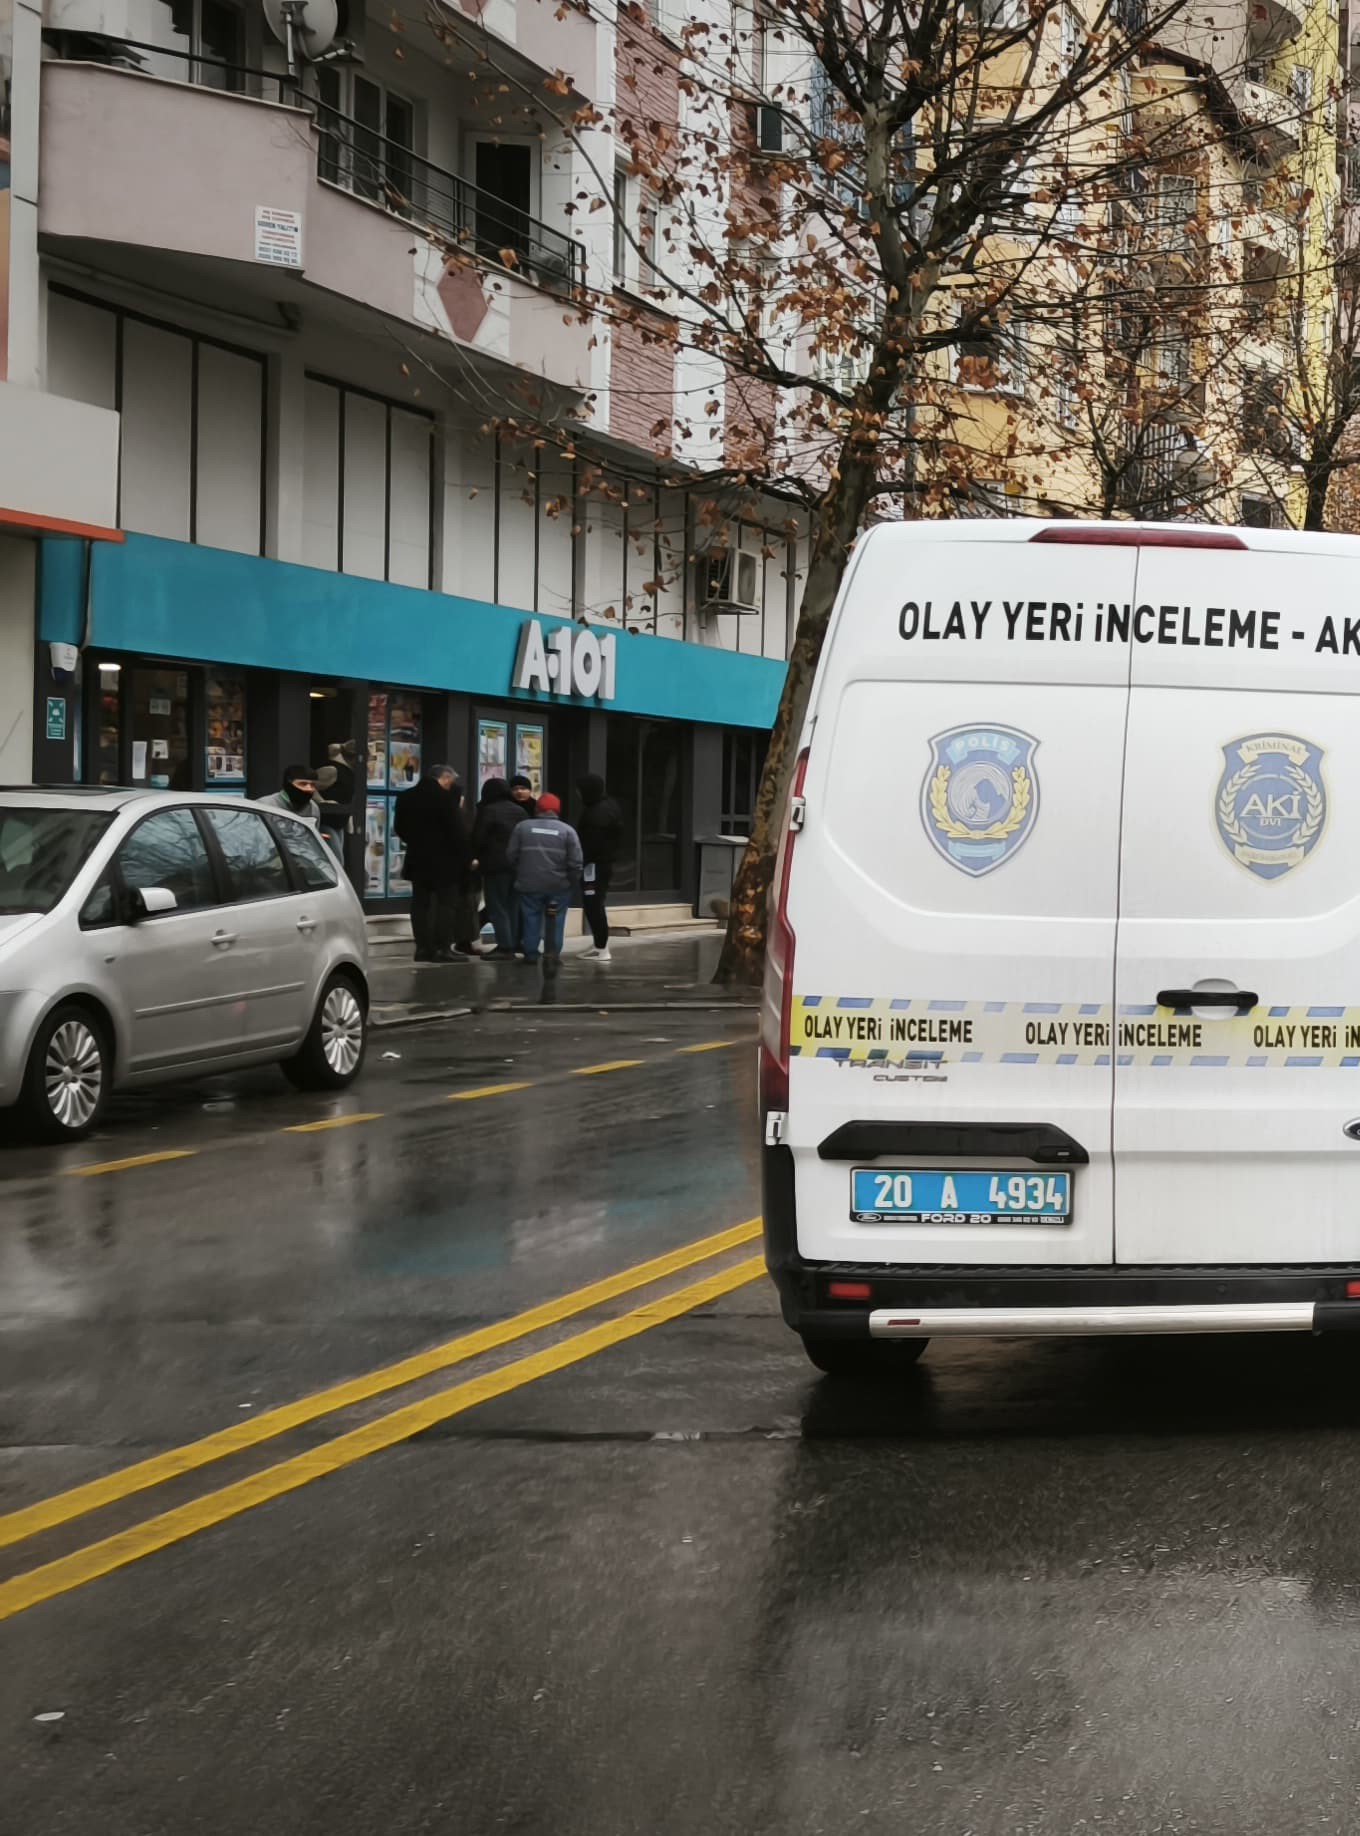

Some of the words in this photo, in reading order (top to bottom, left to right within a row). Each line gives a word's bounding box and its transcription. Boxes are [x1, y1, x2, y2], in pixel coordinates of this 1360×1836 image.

[899, 601, 992, 640] OLAY
[804, 1015, 842, 1038] OLAY
[1025, 1022, 1068, 1045] OLAY
[1254, 1025, 1296, 1048] OLAY
[874, 1175, 912, 1208] 20
[941, 1176, 959, 1209] A
[989, 1177, 1063, 1210] 4934
[921, 1213, 966, 1223] FORD
[970, 1214, 992, 1224] 20
